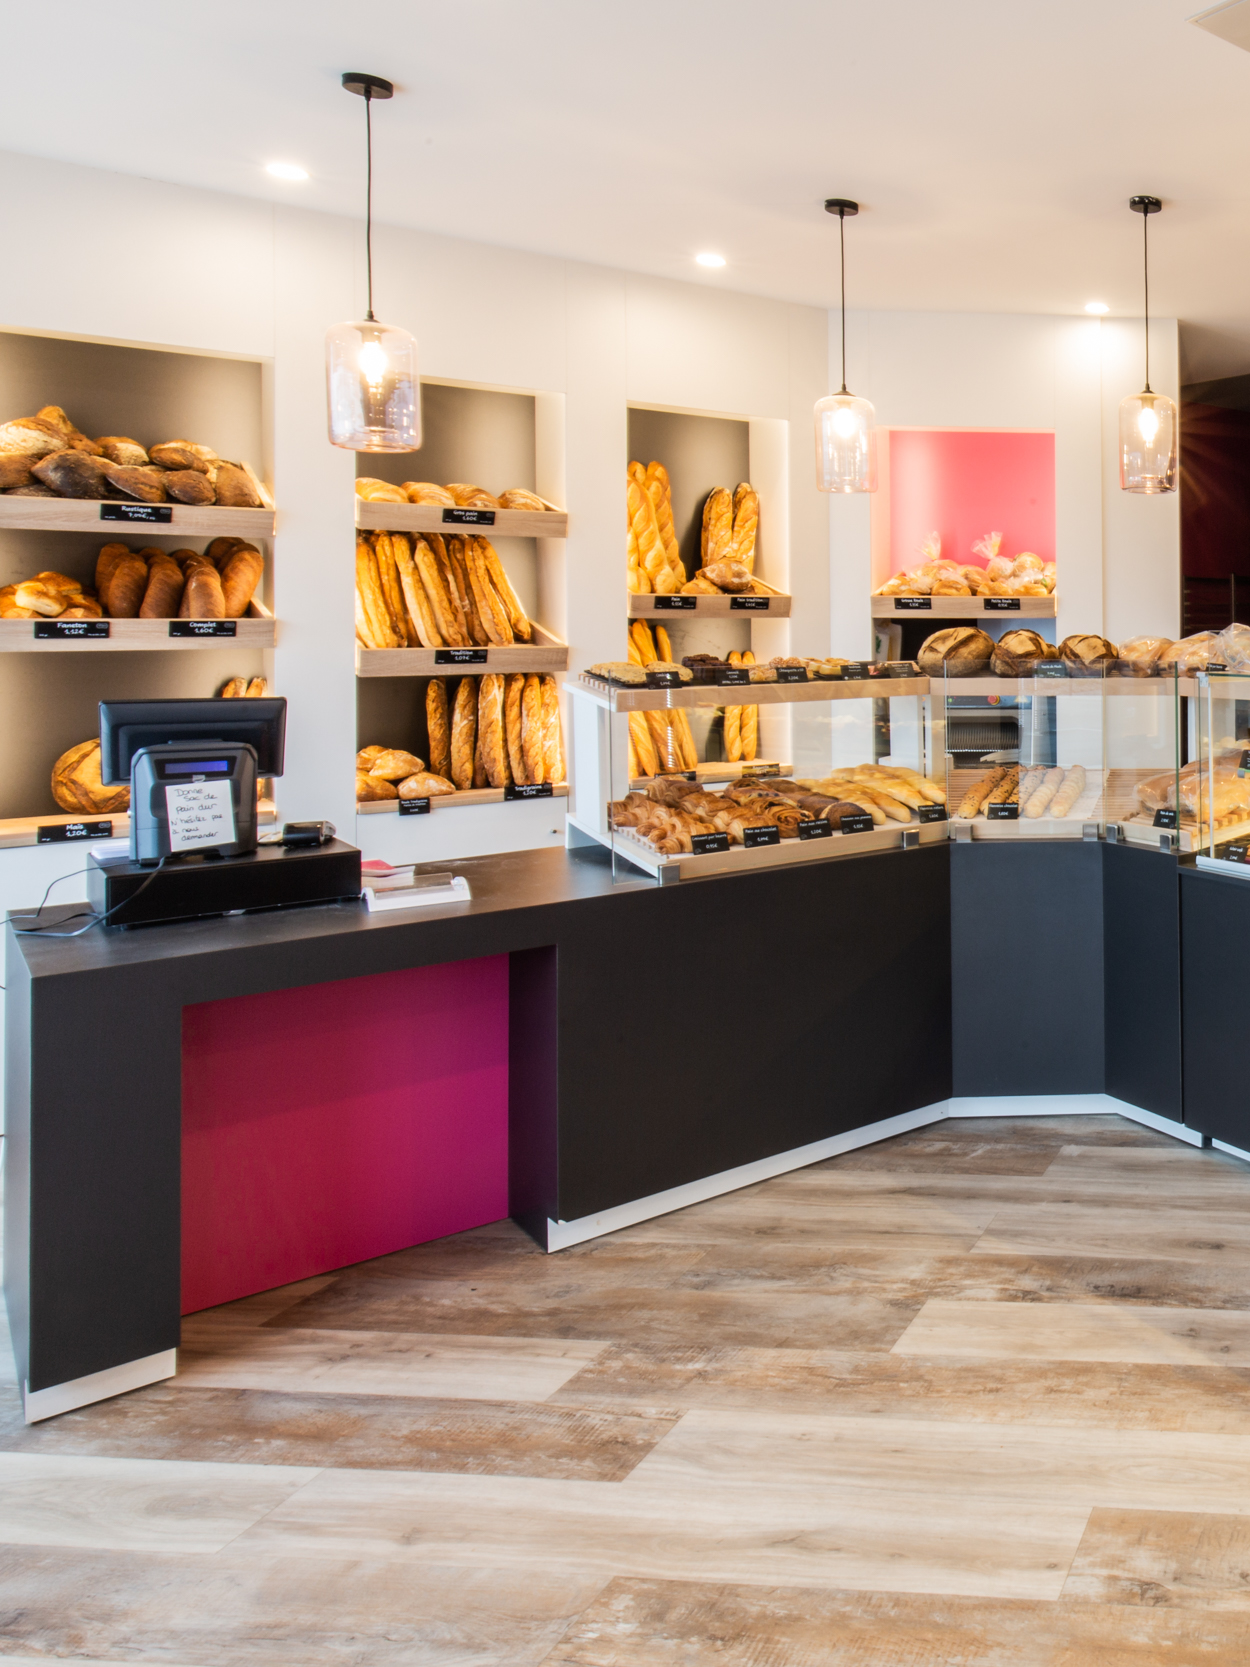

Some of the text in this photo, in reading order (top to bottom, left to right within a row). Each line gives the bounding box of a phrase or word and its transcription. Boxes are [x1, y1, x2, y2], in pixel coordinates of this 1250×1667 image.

[121, 505, 152, 514] Rustique
[189, 621, 217, 629] Complet
[198, 803, 217, 811] dur
[66, 829, 88, 837] 1,20€
[181, 831, 219, 842] demander
